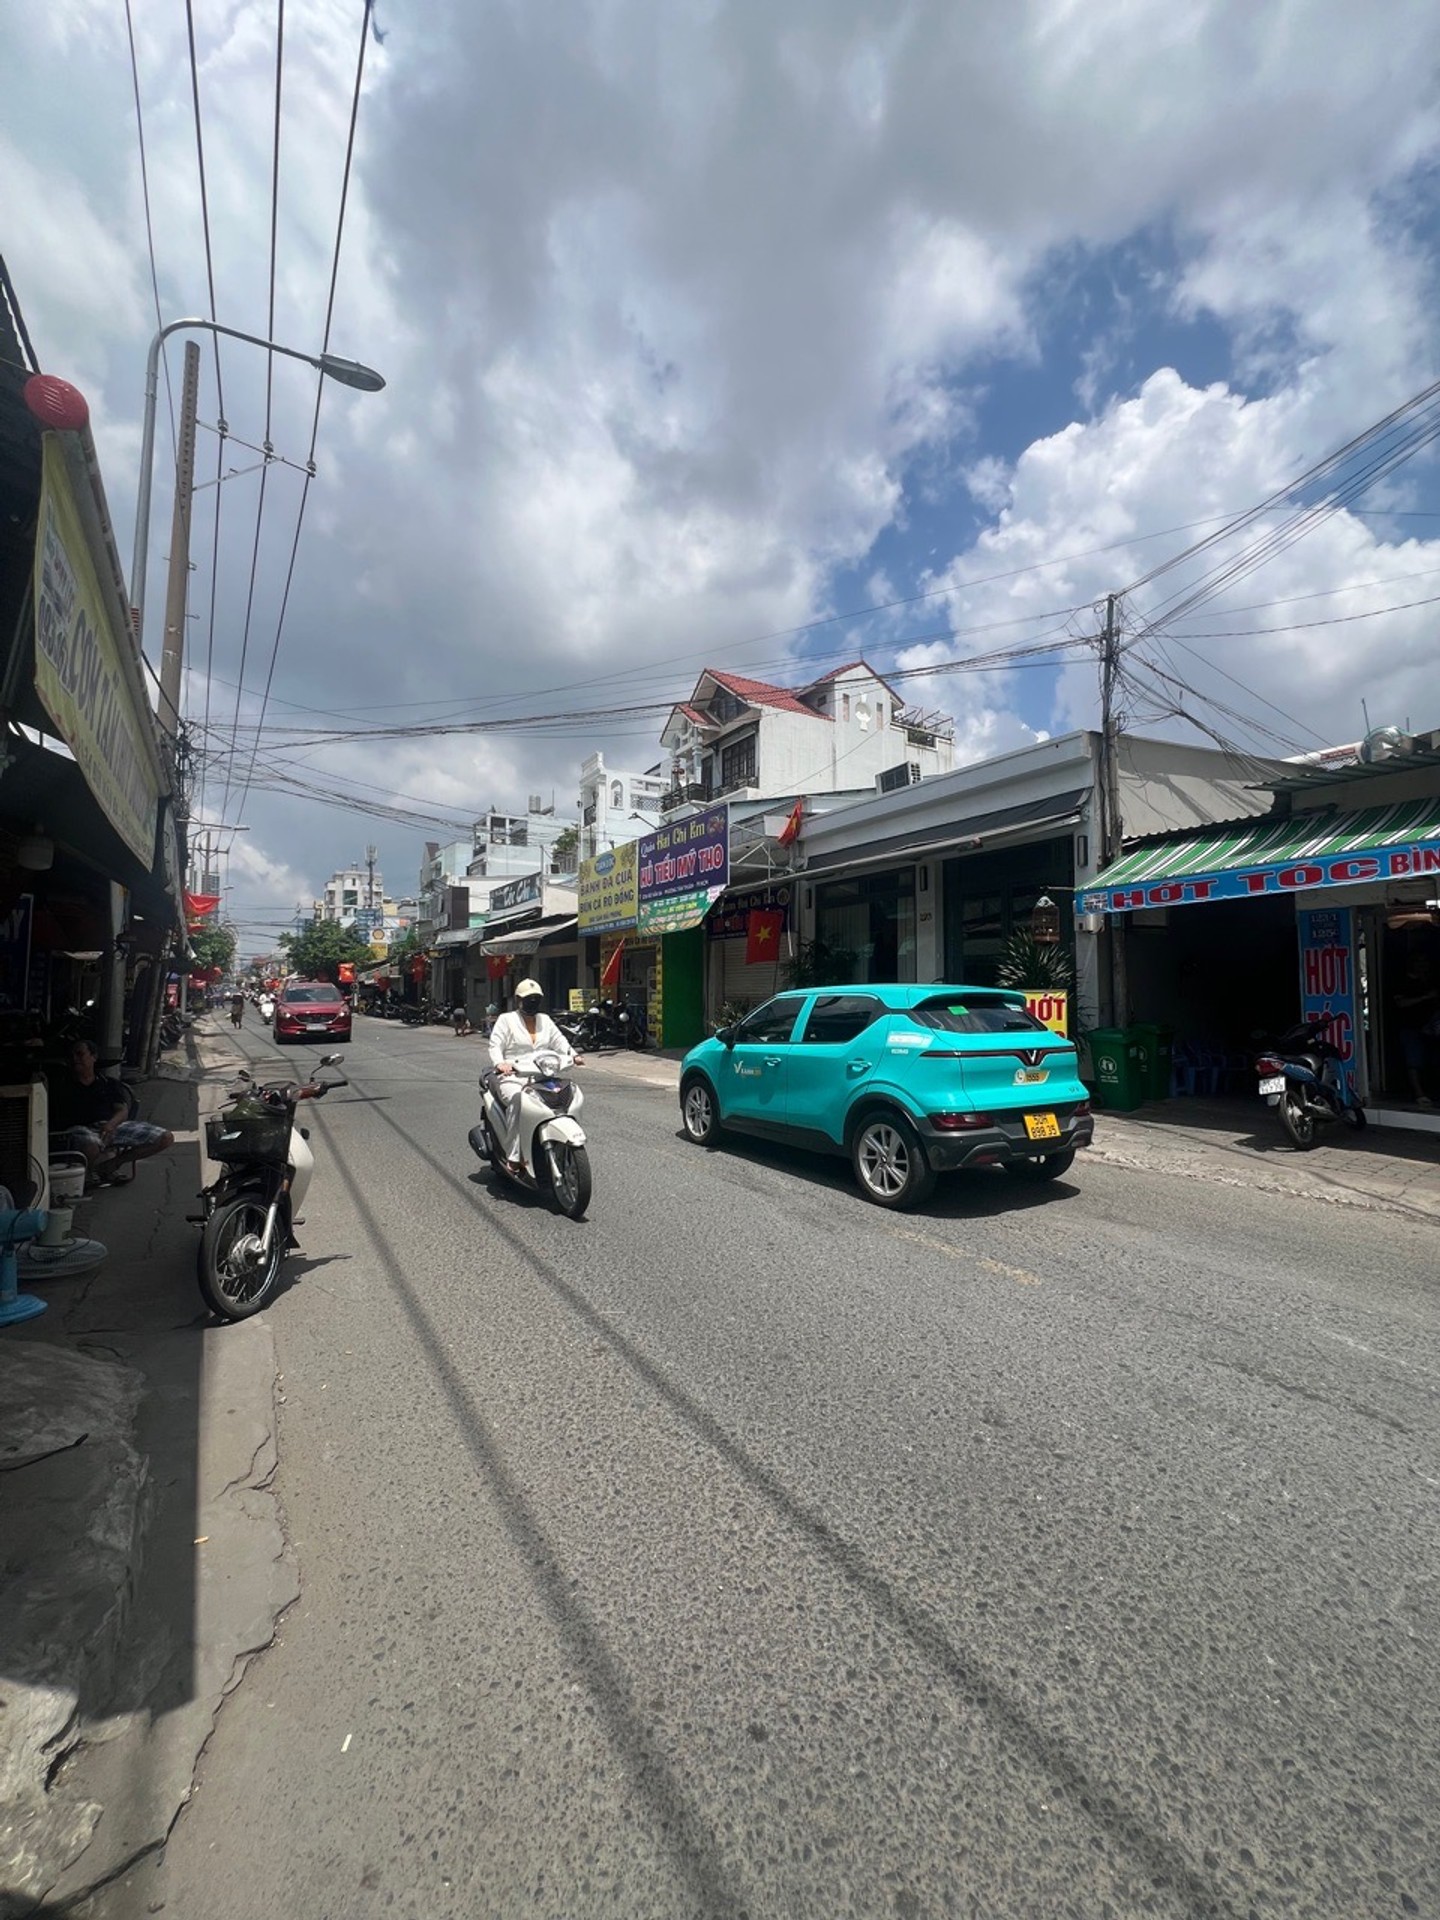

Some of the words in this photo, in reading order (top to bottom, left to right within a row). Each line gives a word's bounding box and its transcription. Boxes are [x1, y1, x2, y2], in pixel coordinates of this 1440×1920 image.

[676, 847, 697, 879] MỸ
[697, 842, 725, 873] THO
[1304, 941, 1349, 997] HỚT
